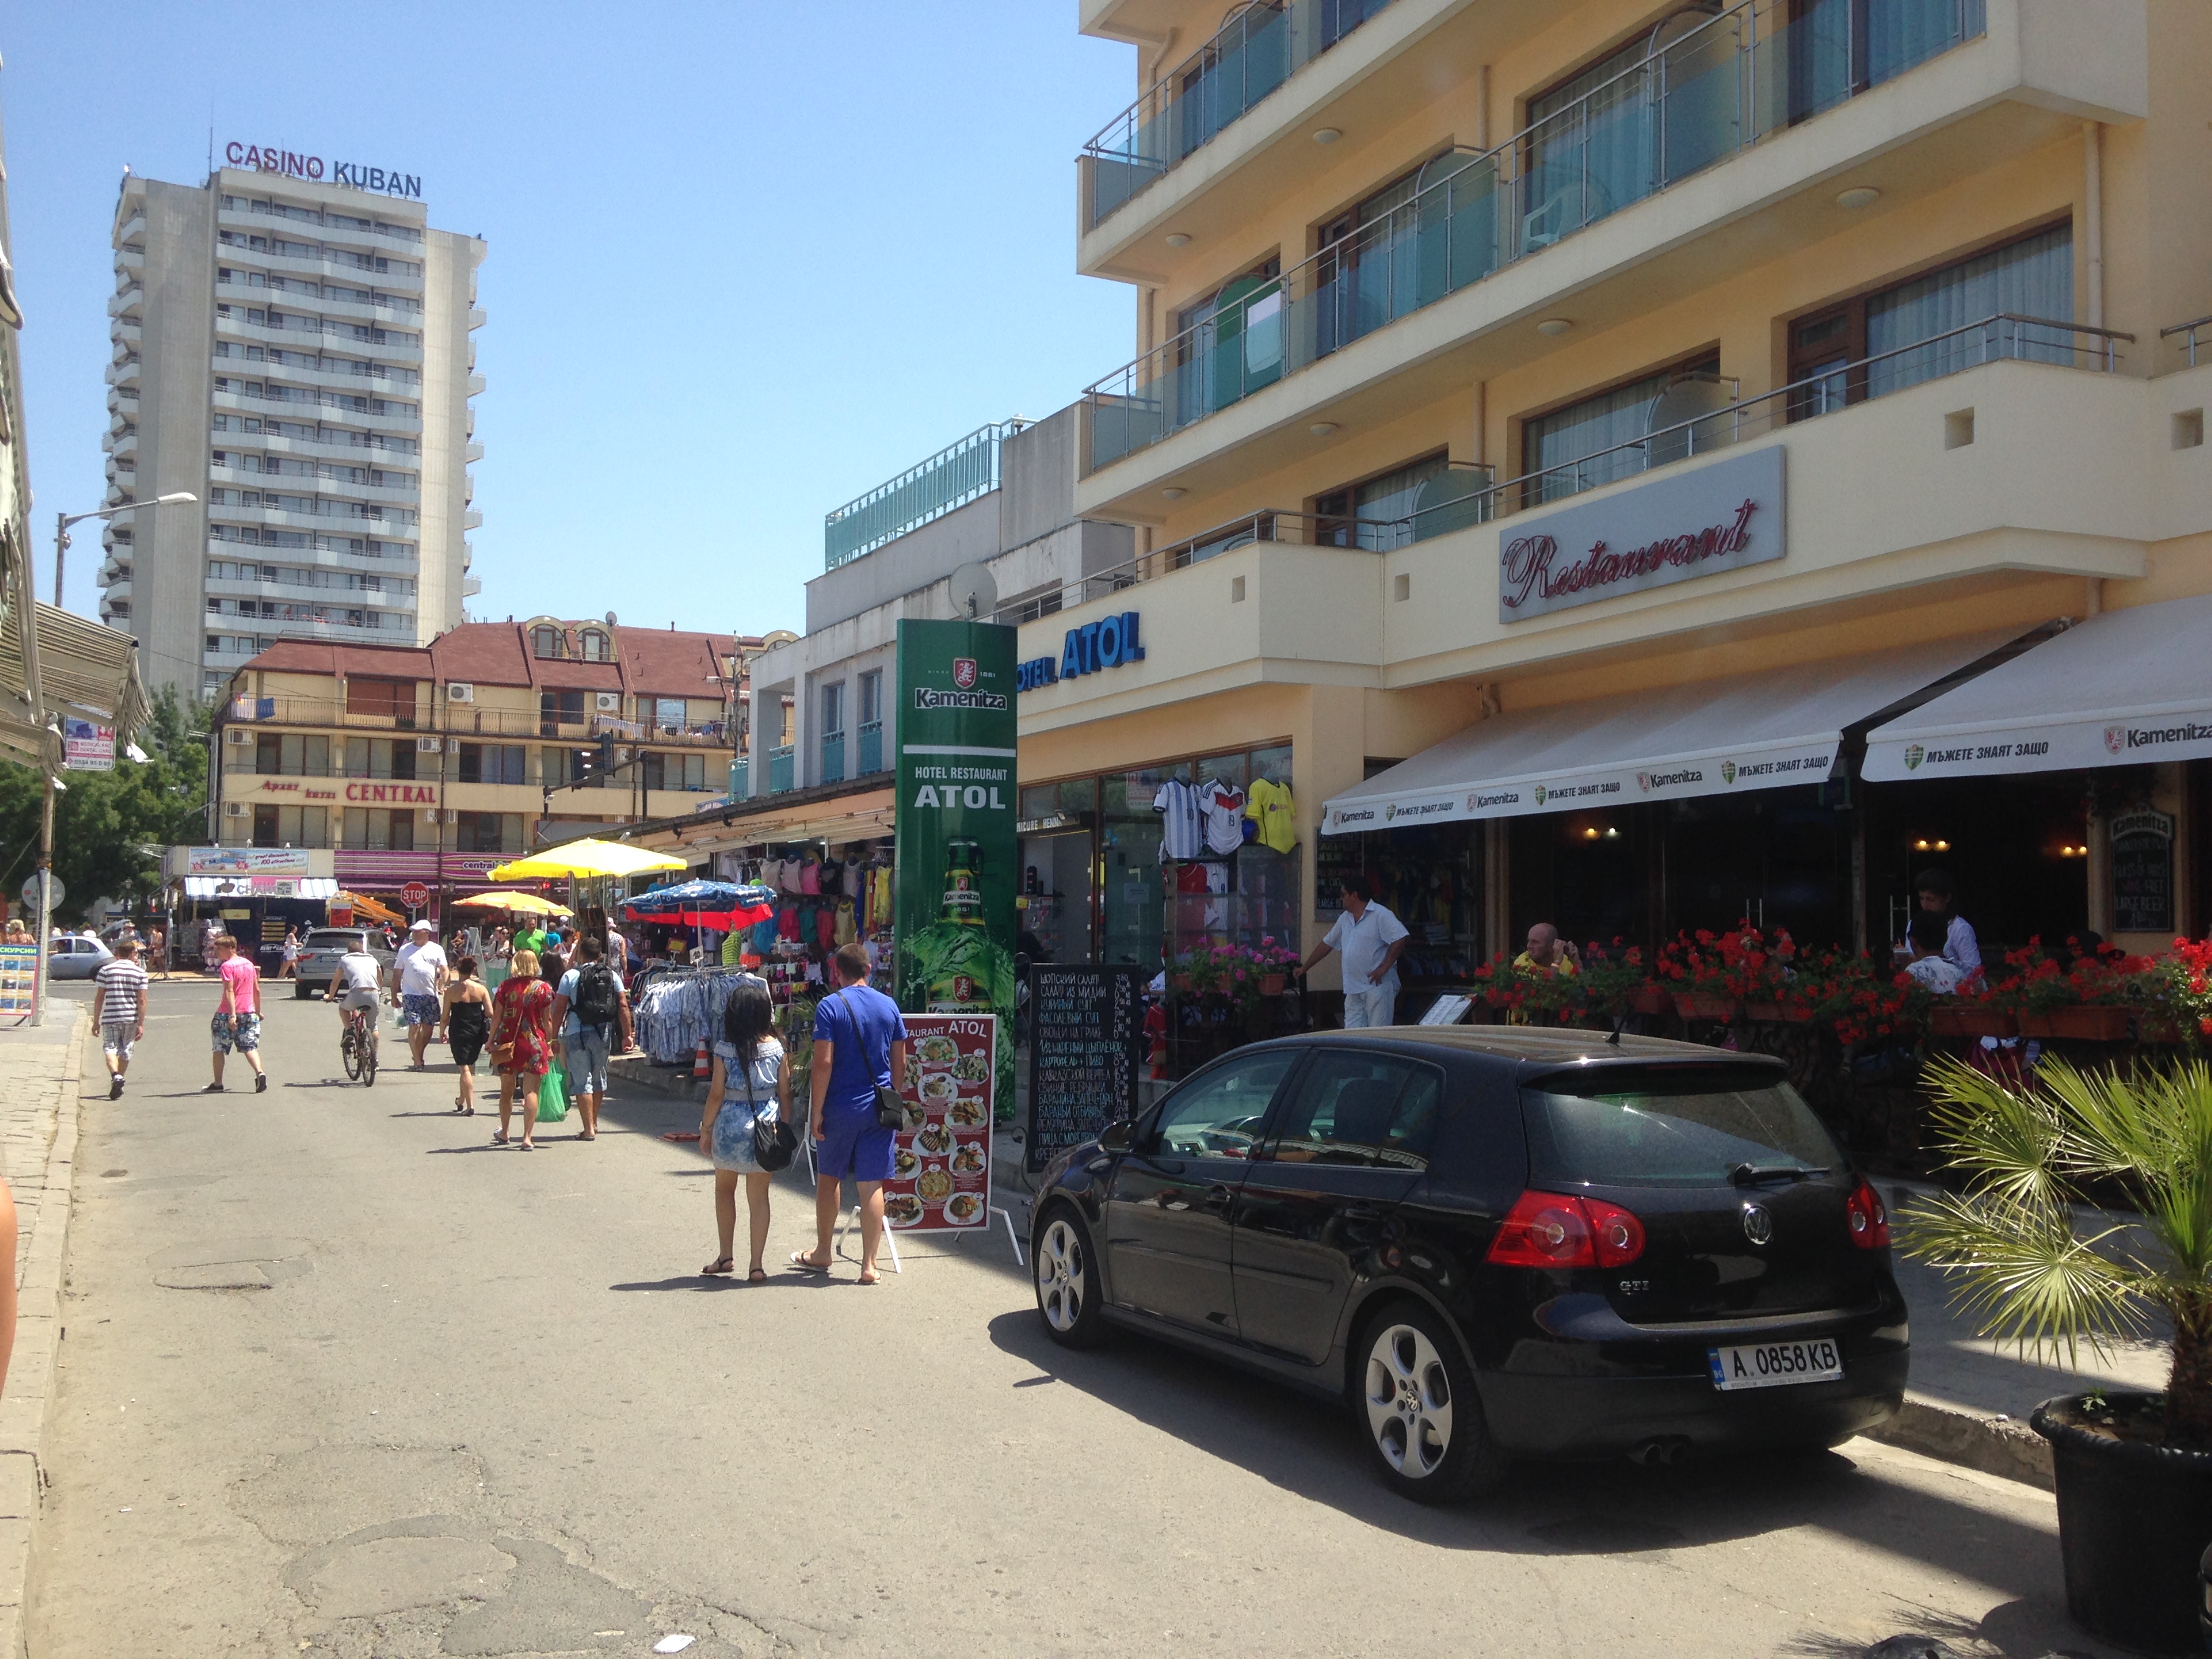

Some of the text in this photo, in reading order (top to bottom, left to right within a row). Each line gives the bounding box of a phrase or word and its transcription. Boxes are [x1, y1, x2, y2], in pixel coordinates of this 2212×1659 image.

[226, 142, 421, 197] CASINO KUBAN
[1502, 498, 1758, 608] Restaurant
[1017, 611, 1145, 693] OTEL ATOL
[916, 688, 1007, 710] Kamenitza
[1927, 741, 2049, 764] МЪЖЕТЕ ЗНАЯТ ЗАЩО
[916, 766, 1008, 781] HOTEL RESTAURANT
[1738, 755, 1828, 777] МЪЖЕТЕ ЗНАЯТ ЗАЩО
[1650, 770, 1702, 788] Kamenitza
[346, 783, 436, 803] CENTRAL
[914, 785, 1006, 809] ATOL
[1549, 782, 1620, 799] МЪЖЕТЕ ЗНАЯТ ЗАЩО
[1477, 792, 1519, 809] Kamenitza
[1341, 809, 1374, 824] Kamenitza
[1396, 802, 1454, 817] МЪЖЕТЕ ЗНАЯТ ЗАЩО
[1017, 819, 1038, 832] NICURE
[463, 861, 495, 869] central
[403, 890, 426, 899] STOP
[944, 890, 980, 902] Kamenitza
[906, 1020, 987, 1038] TAURANT ATOL
[1619, 1280, 1650, 1291] GTI
